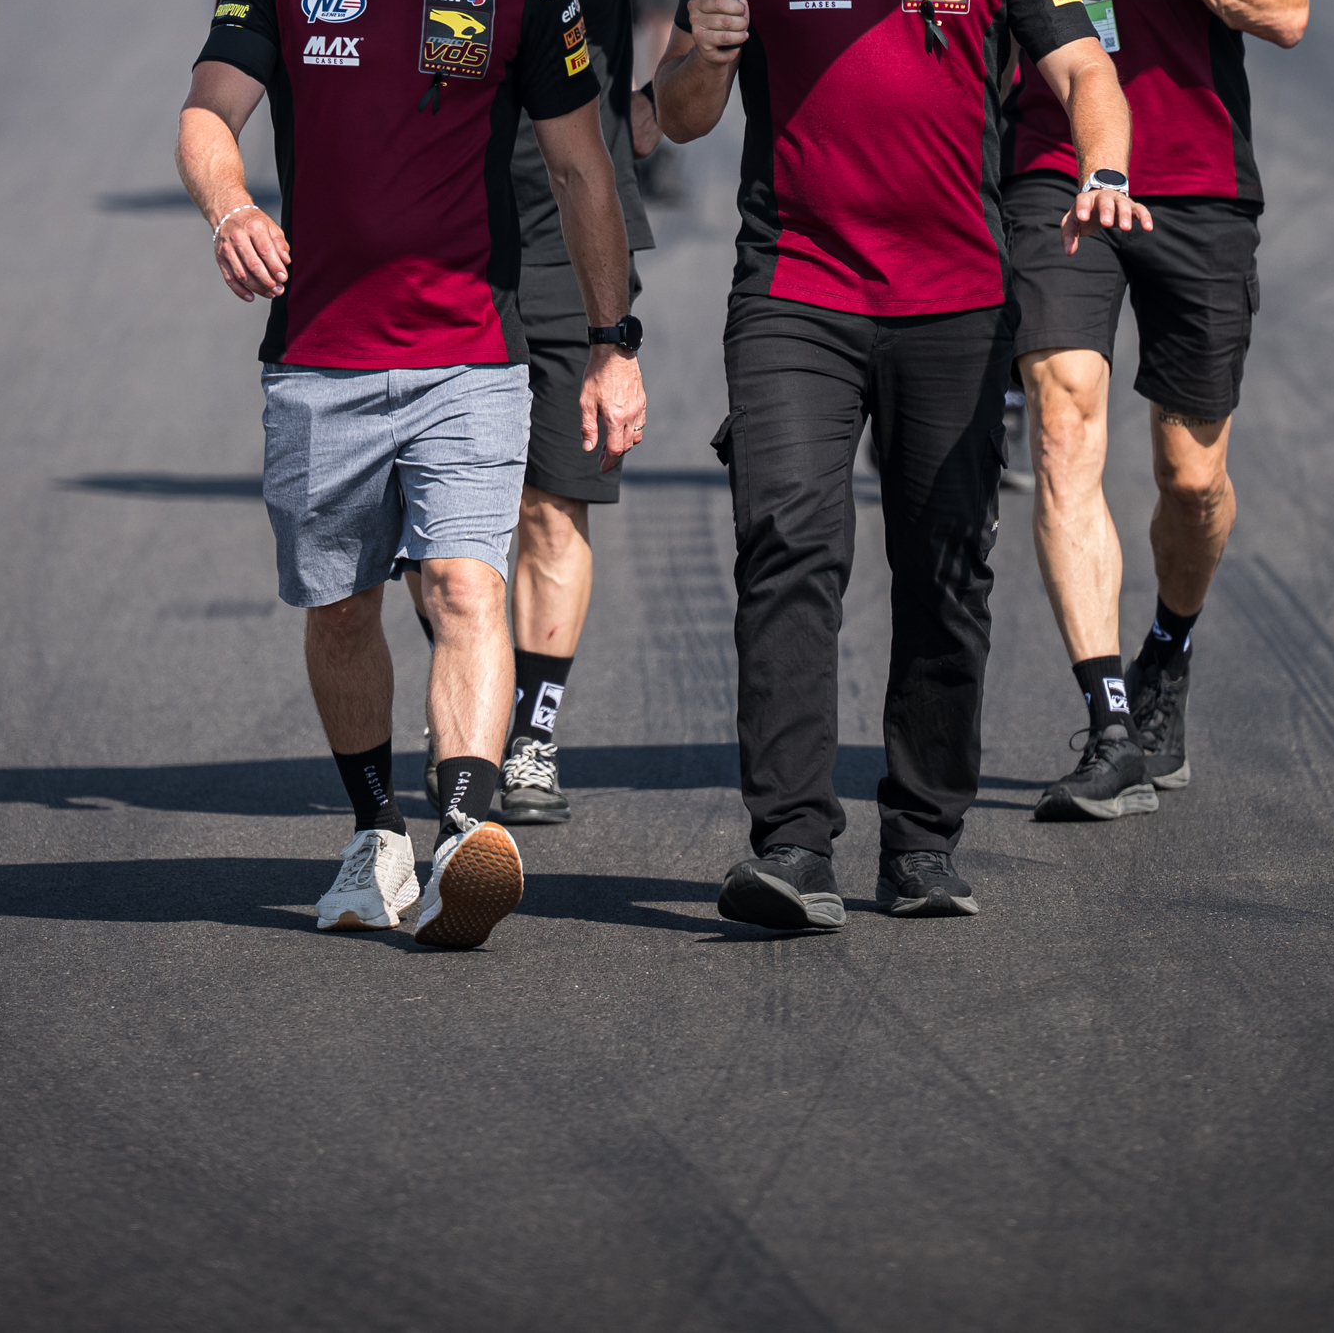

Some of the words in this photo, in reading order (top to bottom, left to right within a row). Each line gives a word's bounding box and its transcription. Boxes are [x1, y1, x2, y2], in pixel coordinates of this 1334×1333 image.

[562, 2, 576, 23] elf
[303, 36, 359, 57] MAX
[427, 36, 464, 46] marc
[315, 57, 344, 65] CASES
[424, 40, 488, 67] vds
